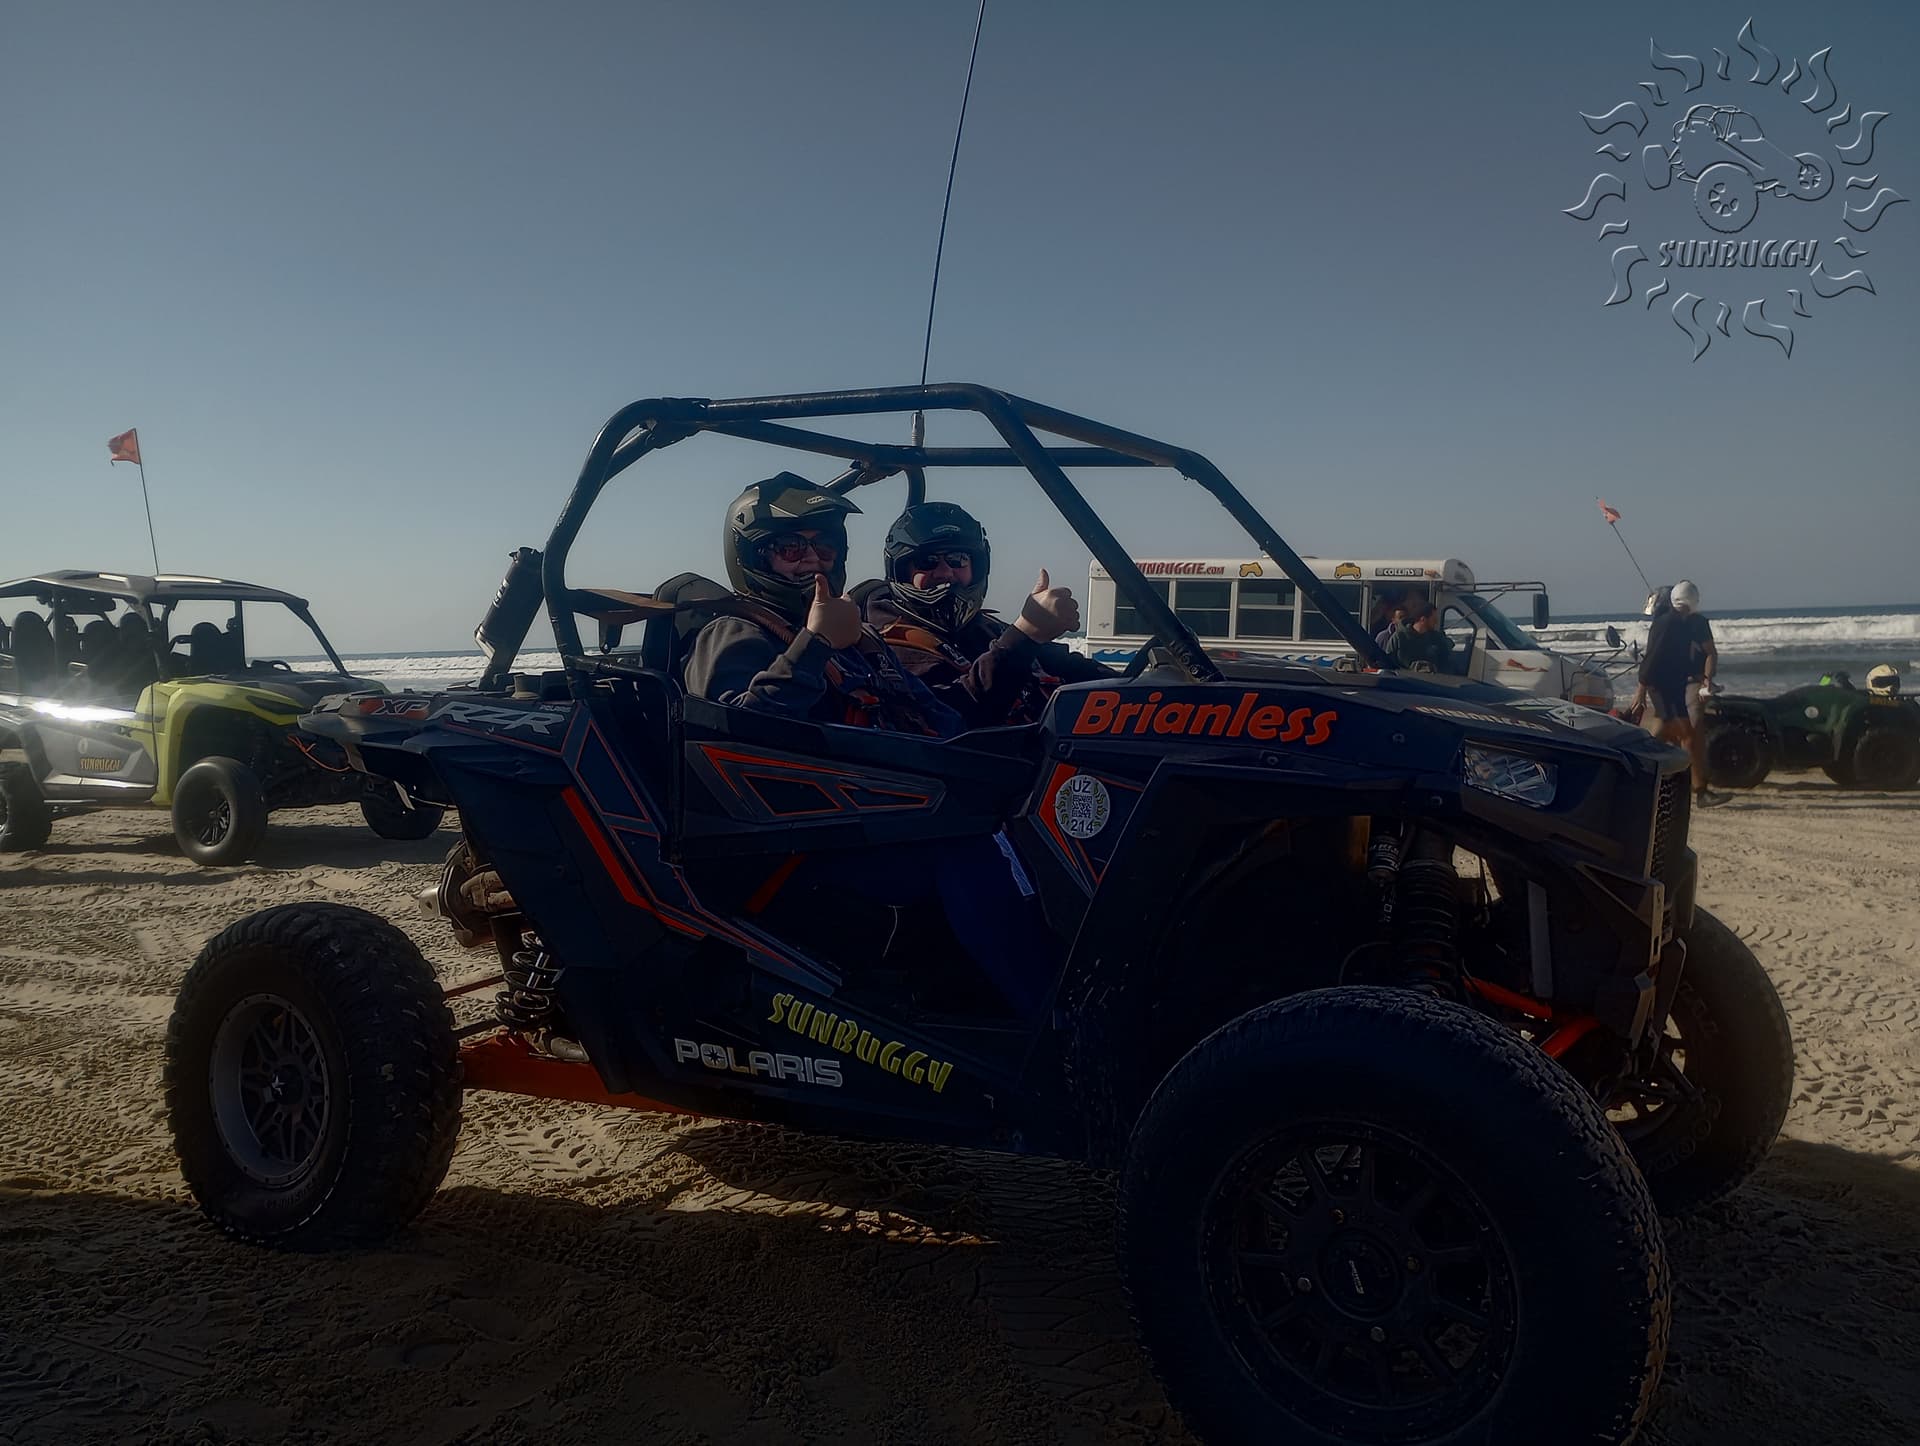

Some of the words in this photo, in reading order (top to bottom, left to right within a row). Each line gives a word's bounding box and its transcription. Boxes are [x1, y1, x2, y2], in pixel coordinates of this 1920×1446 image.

[425, 701, 565, 736] RZR
[1071, 690, 1338, 746] Brianless
[1070, 819, 1093, 833] 214
[674, 1037, 843, 1088] POLARIS
[767, 992, 953, 1094] SUNBUGGY
